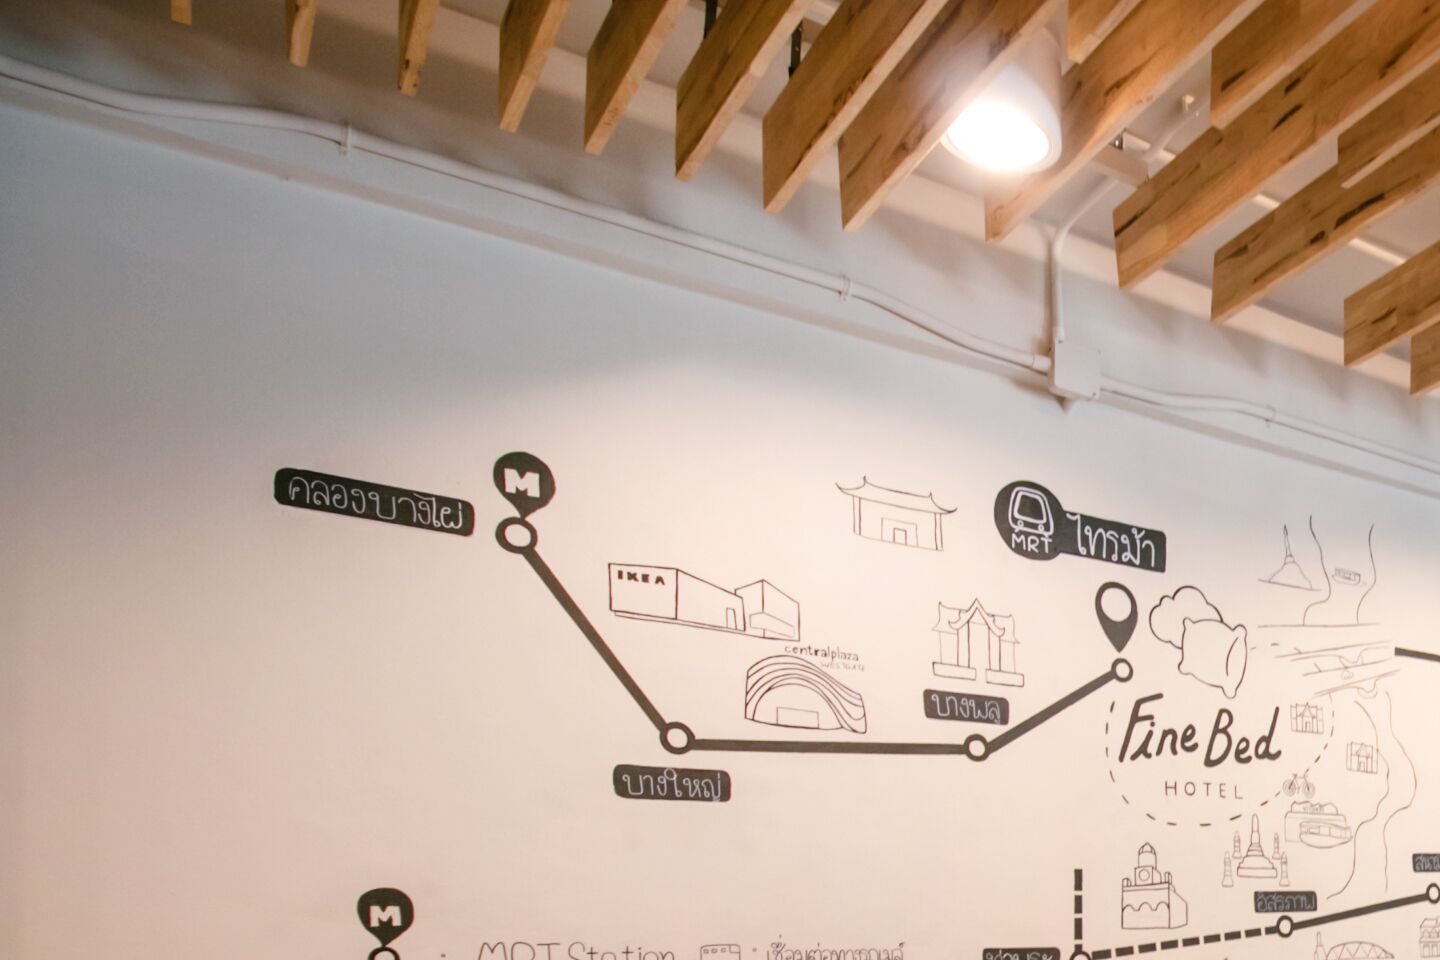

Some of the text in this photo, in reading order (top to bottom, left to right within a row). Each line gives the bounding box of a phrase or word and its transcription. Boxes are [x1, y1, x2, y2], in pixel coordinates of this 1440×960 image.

[504, 467, 541, 498] M
[287, 476, 464, 530] คลองบางไผ่
[1011, 532, 1053, 554] MRT
[1066, 512, 1156, 568] ไทรม้า
[617, 569, 666, 585] IKEA
[784, 644, 860, 662] centralplaza
[931, 692, 1001, 725] บางพลู
[1118, 692, 1283, 768] Fine Bed
[621, 767, 721, 802] บางใหญ่
[1164, 780, 1244, 800] HOTEL
[370, 904, 402, 928] M
